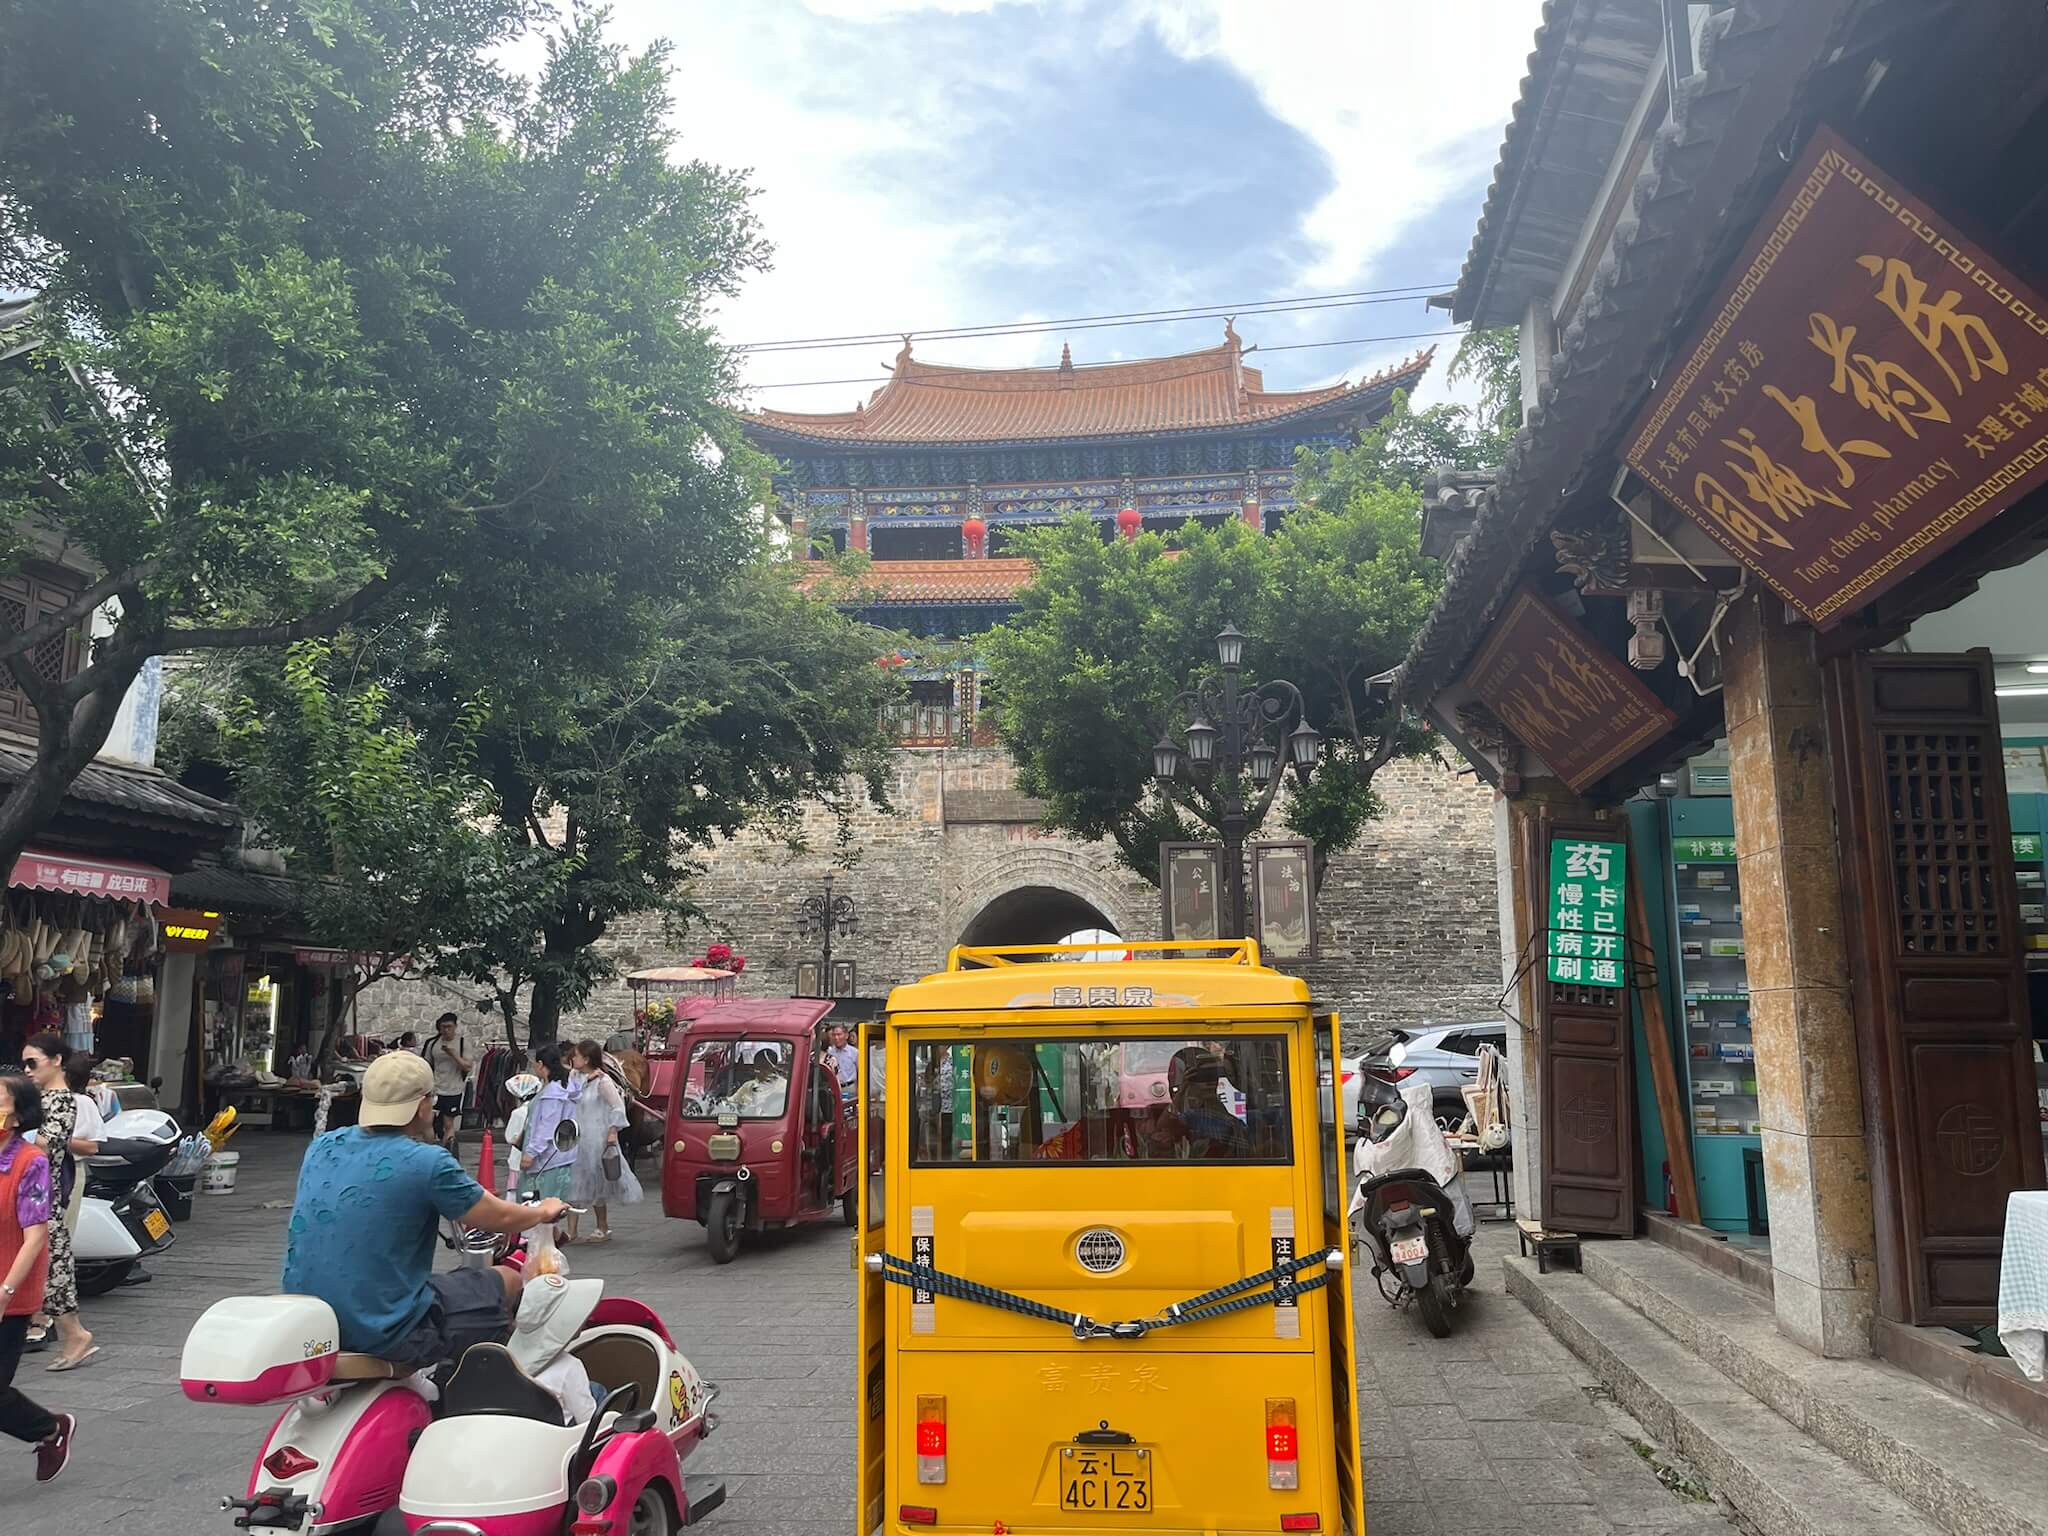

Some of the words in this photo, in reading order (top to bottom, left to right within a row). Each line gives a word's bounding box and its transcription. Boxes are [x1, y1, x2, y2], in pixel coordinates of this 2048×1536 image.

[1656, 340, 1765, 479] 大理市同城大药房
[1694, 254, 2009, 556] 同城大药房
[1793, 555, 1840, 584] Tong
[1829, 521, 1882, 559] cheng
[1872, 457, 1960, 531] pharmacy
[106, 874, 148, 893] 放马来
[1565, 843, 1613, 881] 药
[1556, 883, 1584, 981] 慢性病刷
[1590, 885, 1618, 983] 卡已开通
[1053, 986, 1153, 1007] 富贵泉
[916, 1237, 931, 1303] 保持距
[1040, 1362, 1169, 1394] 富贵泉
[1065, 1479, 1148, 1509] 4C123
